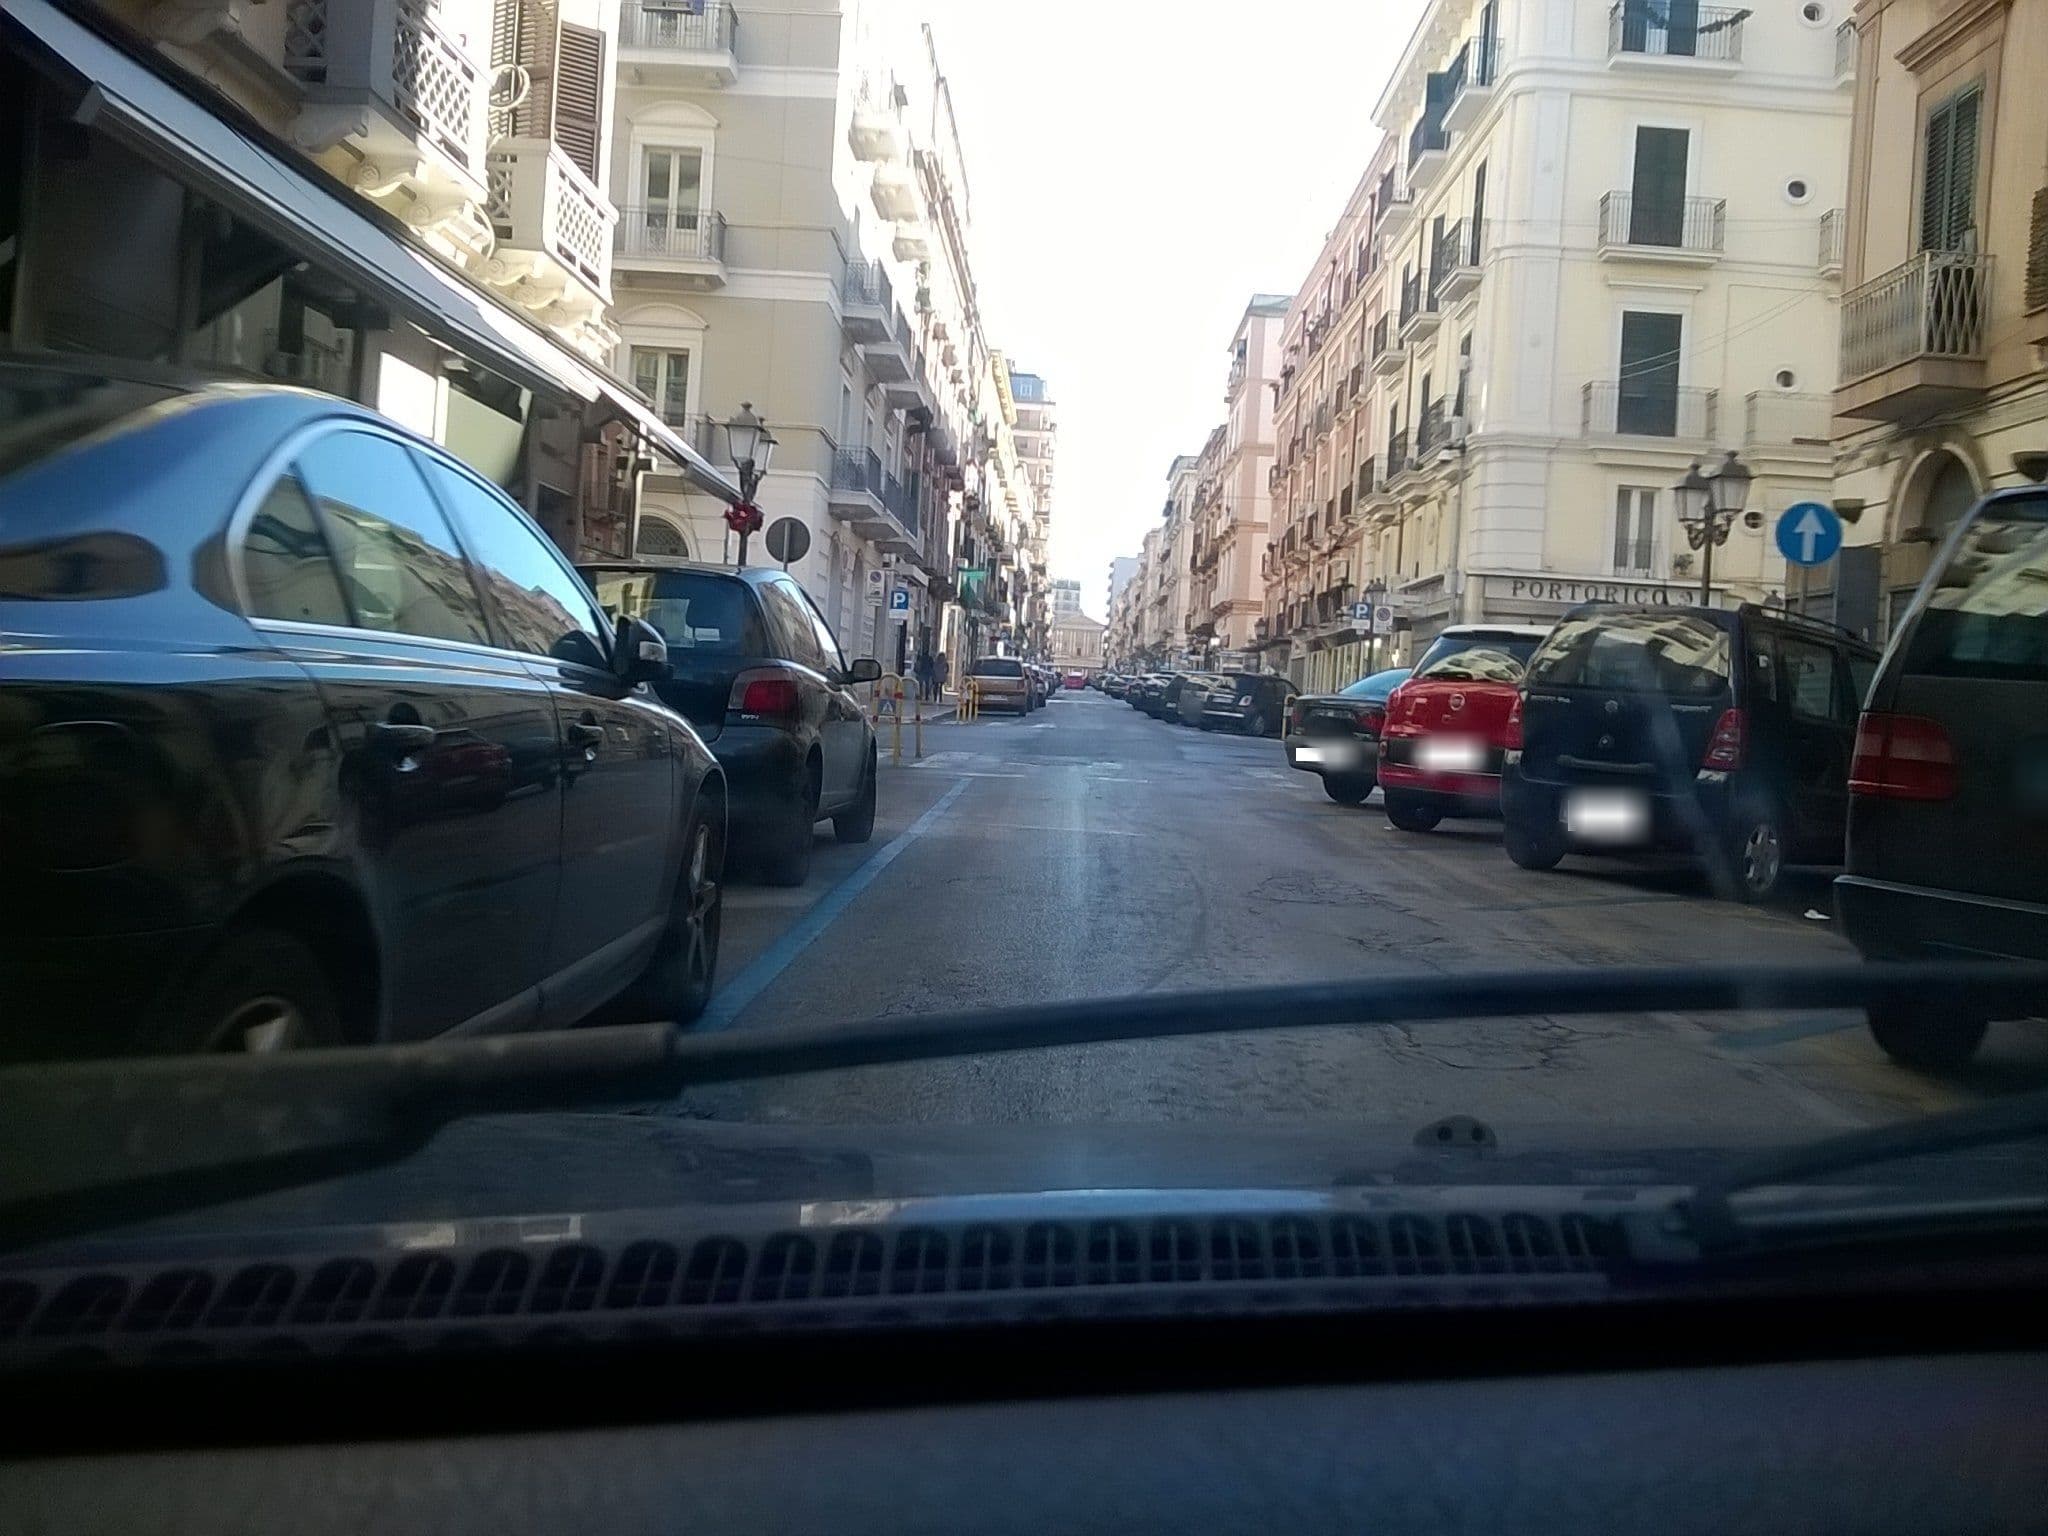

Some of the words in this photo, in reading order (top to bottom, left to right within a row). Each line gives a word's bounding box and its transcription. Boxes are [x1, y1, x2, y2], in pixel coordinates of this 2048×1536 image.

[893, 592, 906, 608] P
[1511, 579, 1669, 606] PORTORICO
[1355, 604, 1368, 618] P
